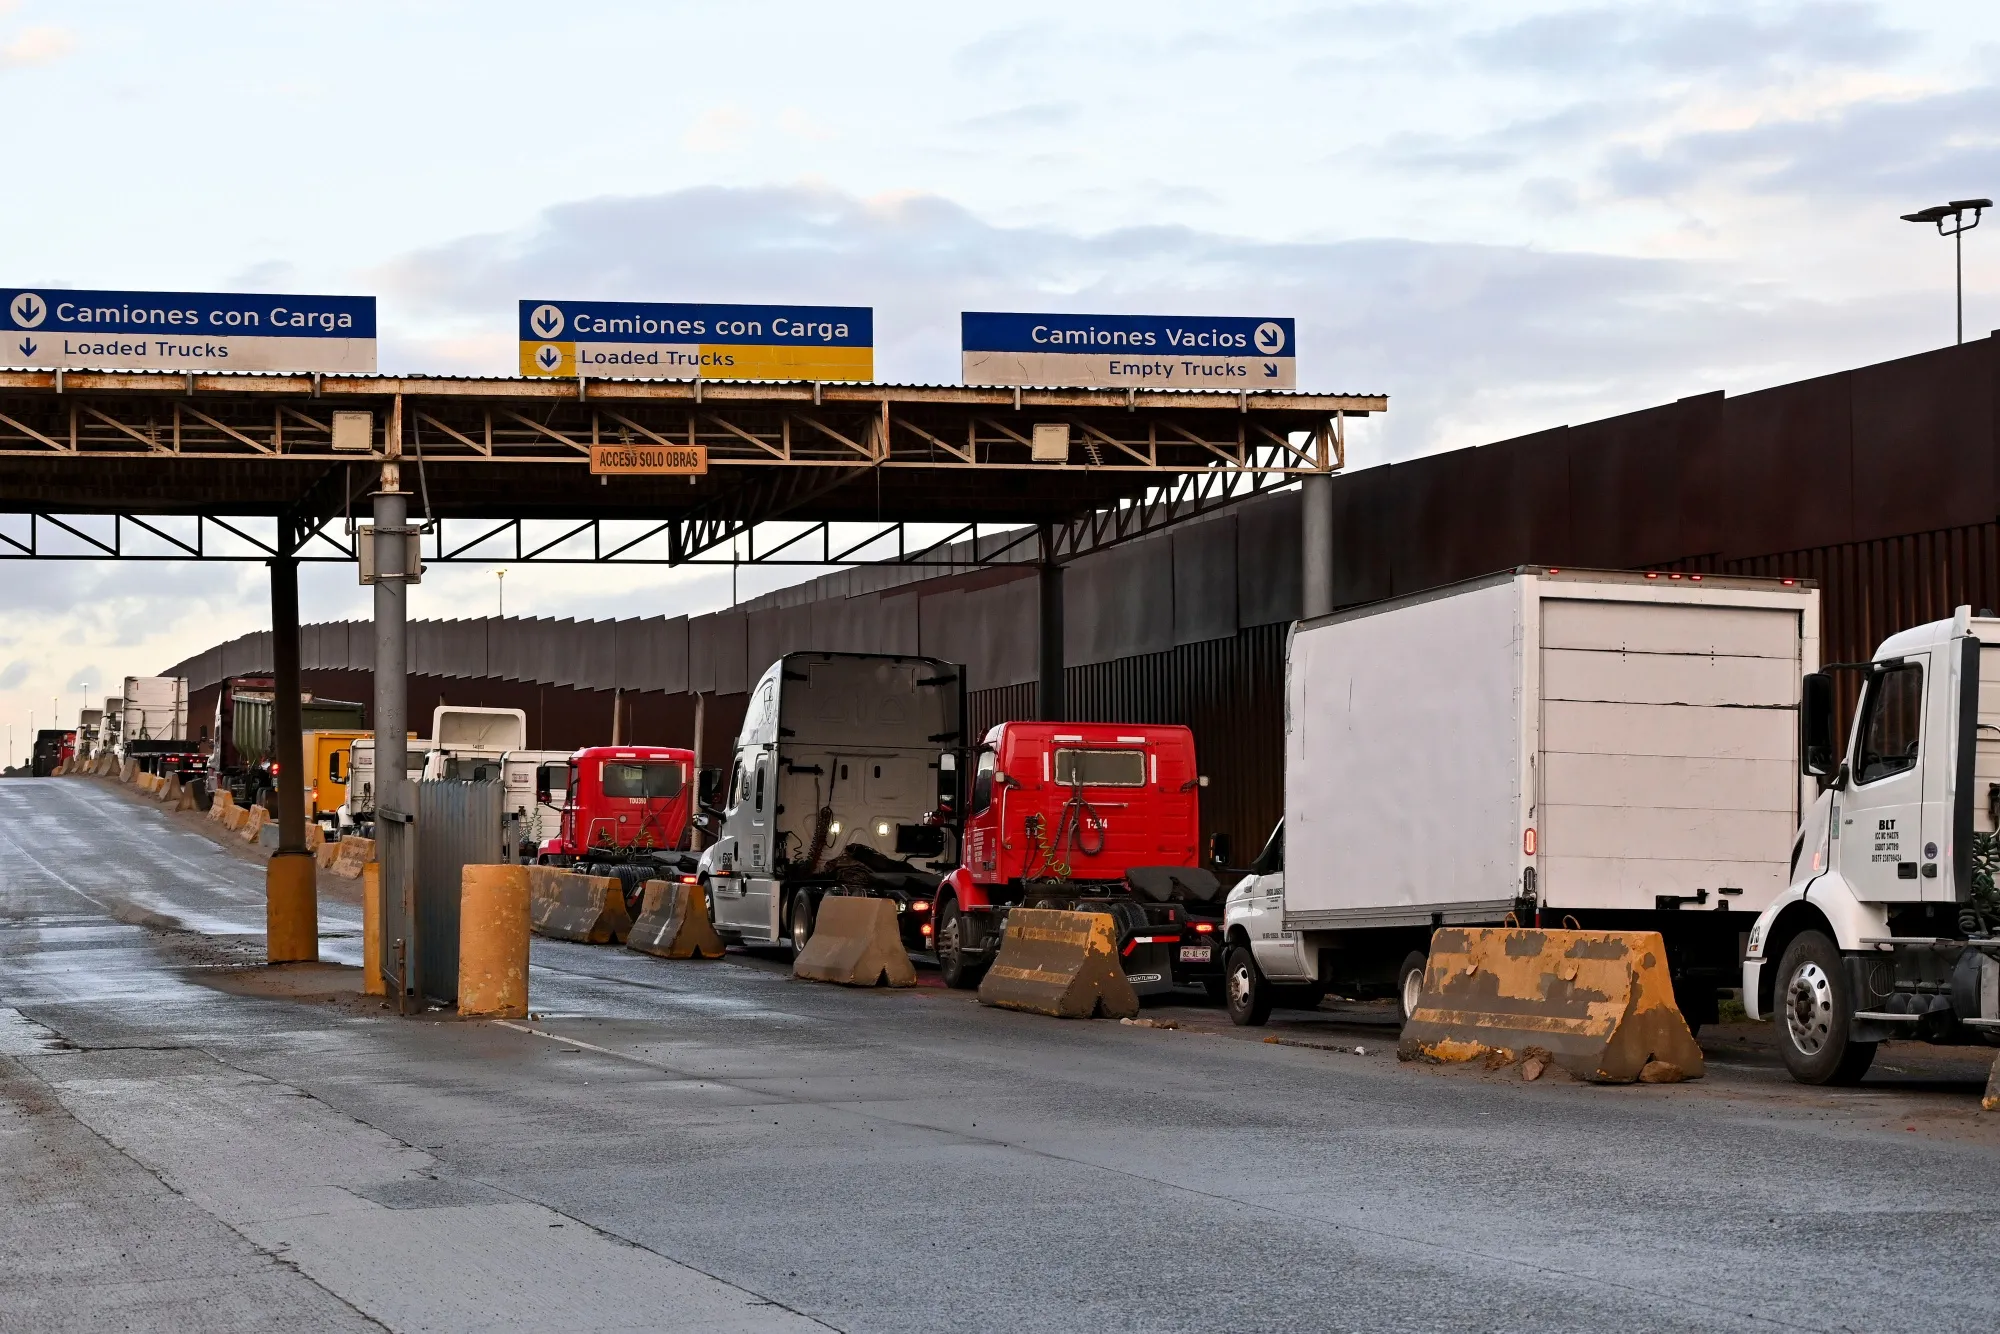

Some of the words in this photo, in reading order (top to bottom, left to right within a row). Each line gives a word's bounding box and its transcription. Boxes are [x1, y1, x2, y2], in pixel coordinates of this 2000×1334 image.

[56, 302, 199, 325] Camiones
[209, 310, 259, 326] con
[270, 307, 352, 332] Carga
[573, 314, 705, 335] Camiones
[715, 319, 762, 337] con
[772, 318, 849, 342] Carga
[1031, 325, 1157, 346] Camiones
[1165, 328, 1247, 348] Vacios
[64, 339, 147, 356] Loaded
[155, 341, 229, 358] Trucks
[581, 349, 659, 366] Loaded
[665, 351, 735, 367] Trucks
[1109, 360, 1174, 379] Empty
[1180, 361, 1247, 377] Trucks
[600, 451, 637, 467] ACCESO
[640, 451, 663, 468] SOLO
[666, 452, 698, 468] OBRAS
[1878, 819, 1896, 831] BLT
